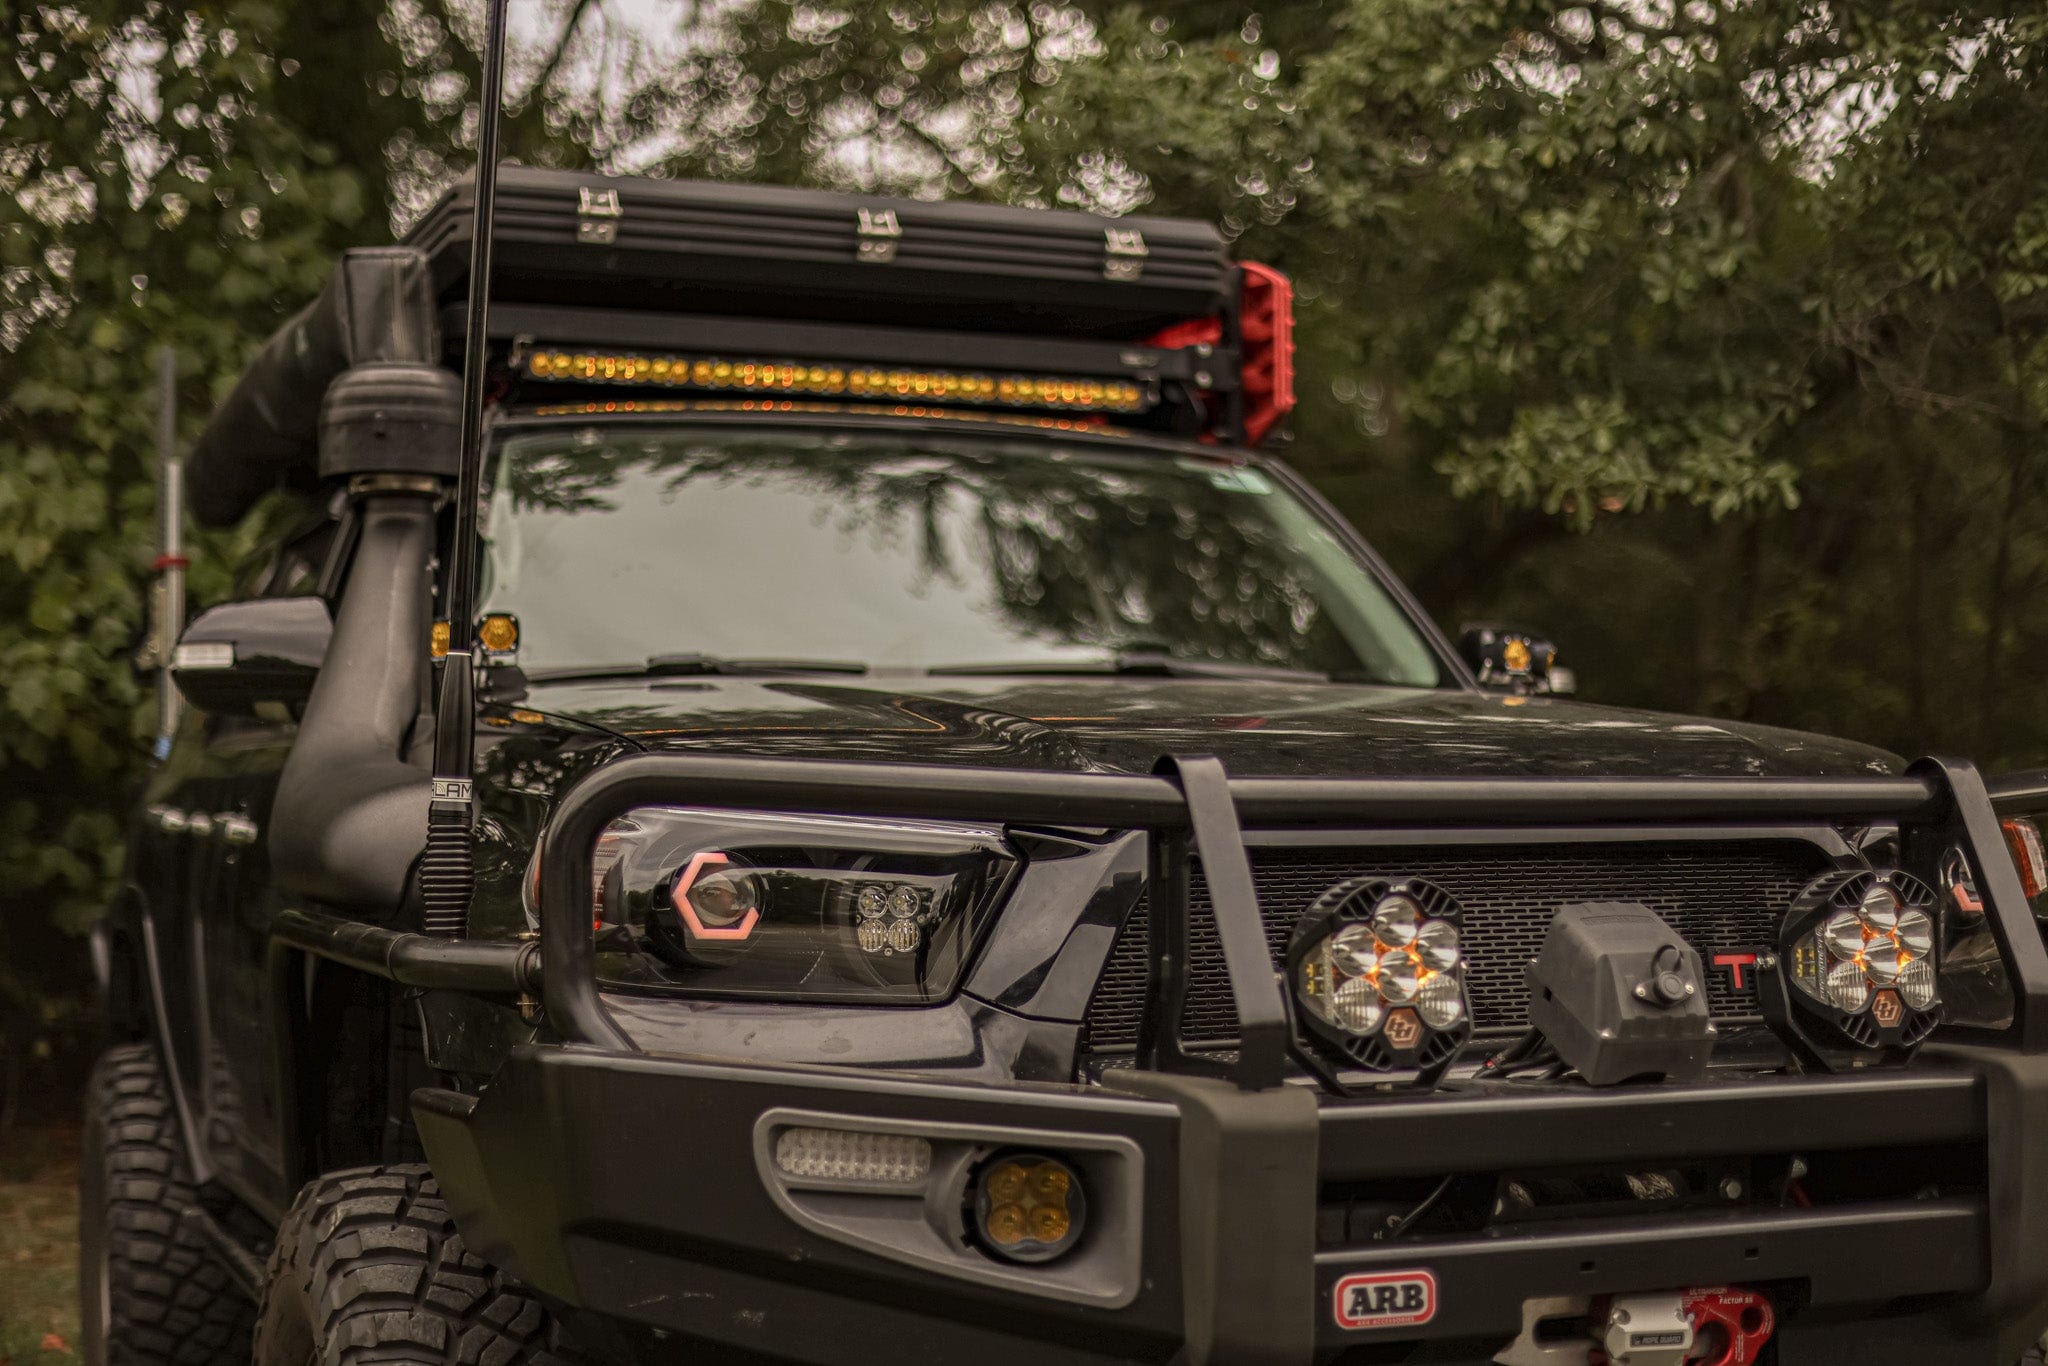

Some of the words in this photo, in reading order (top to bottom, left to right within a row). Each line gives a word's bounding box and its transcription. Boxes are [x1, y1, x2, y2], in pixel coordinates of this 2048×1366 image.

[1347, 1284, 1425, 1317] ARB
[1719, 1296, 1743, 1305] FACTOR
[1660, 1335, 1681, 1344] GUARD
